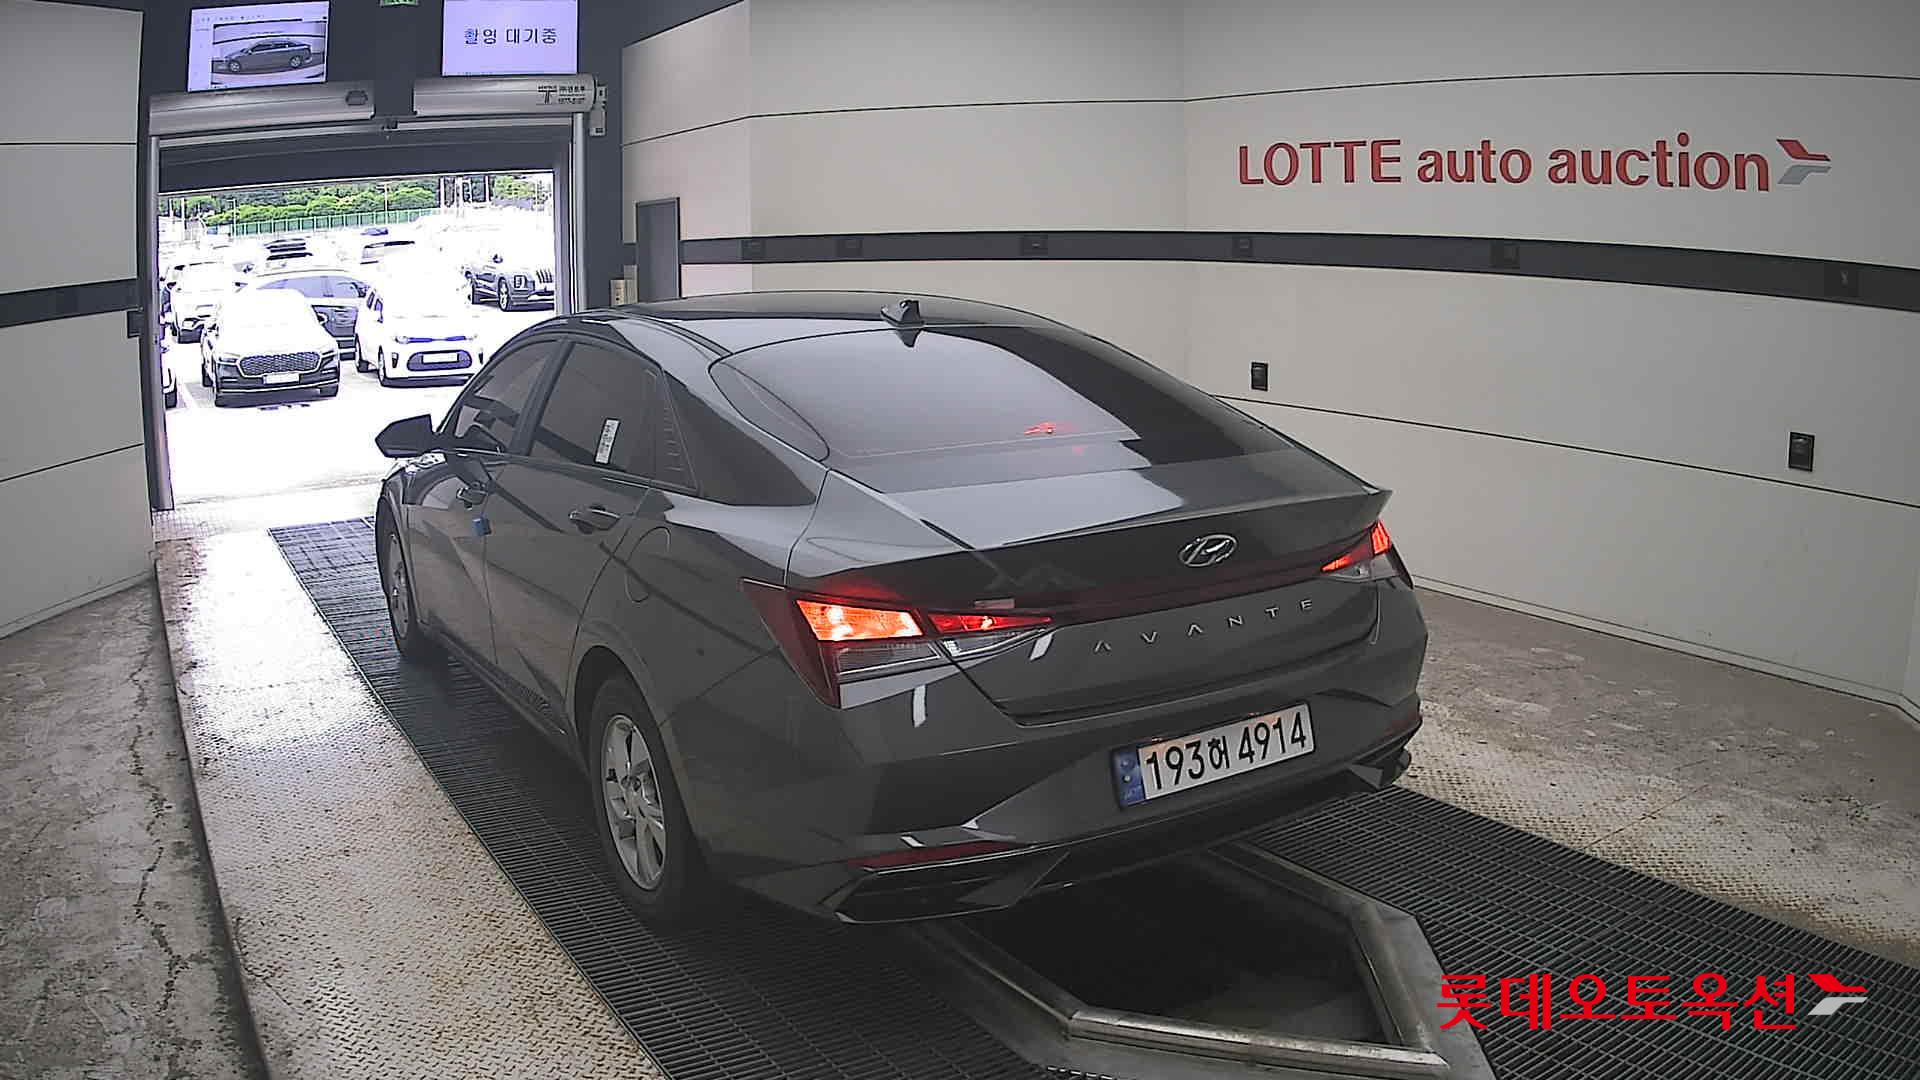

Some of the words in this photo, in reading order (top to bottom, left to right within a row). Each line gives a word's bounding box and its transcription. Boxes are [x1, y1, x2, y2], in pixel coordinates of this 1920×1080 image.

[506, 27, 557, 45] 대기중
[1239, 139, 1402, 186] LOTTE
[1417, 140, 1532, 184] auto
[1548, 132, 1770, 192] auction
[1094, 600, 1313, 652] AVANTE
[1238, 712, 1306, 764] 4914
